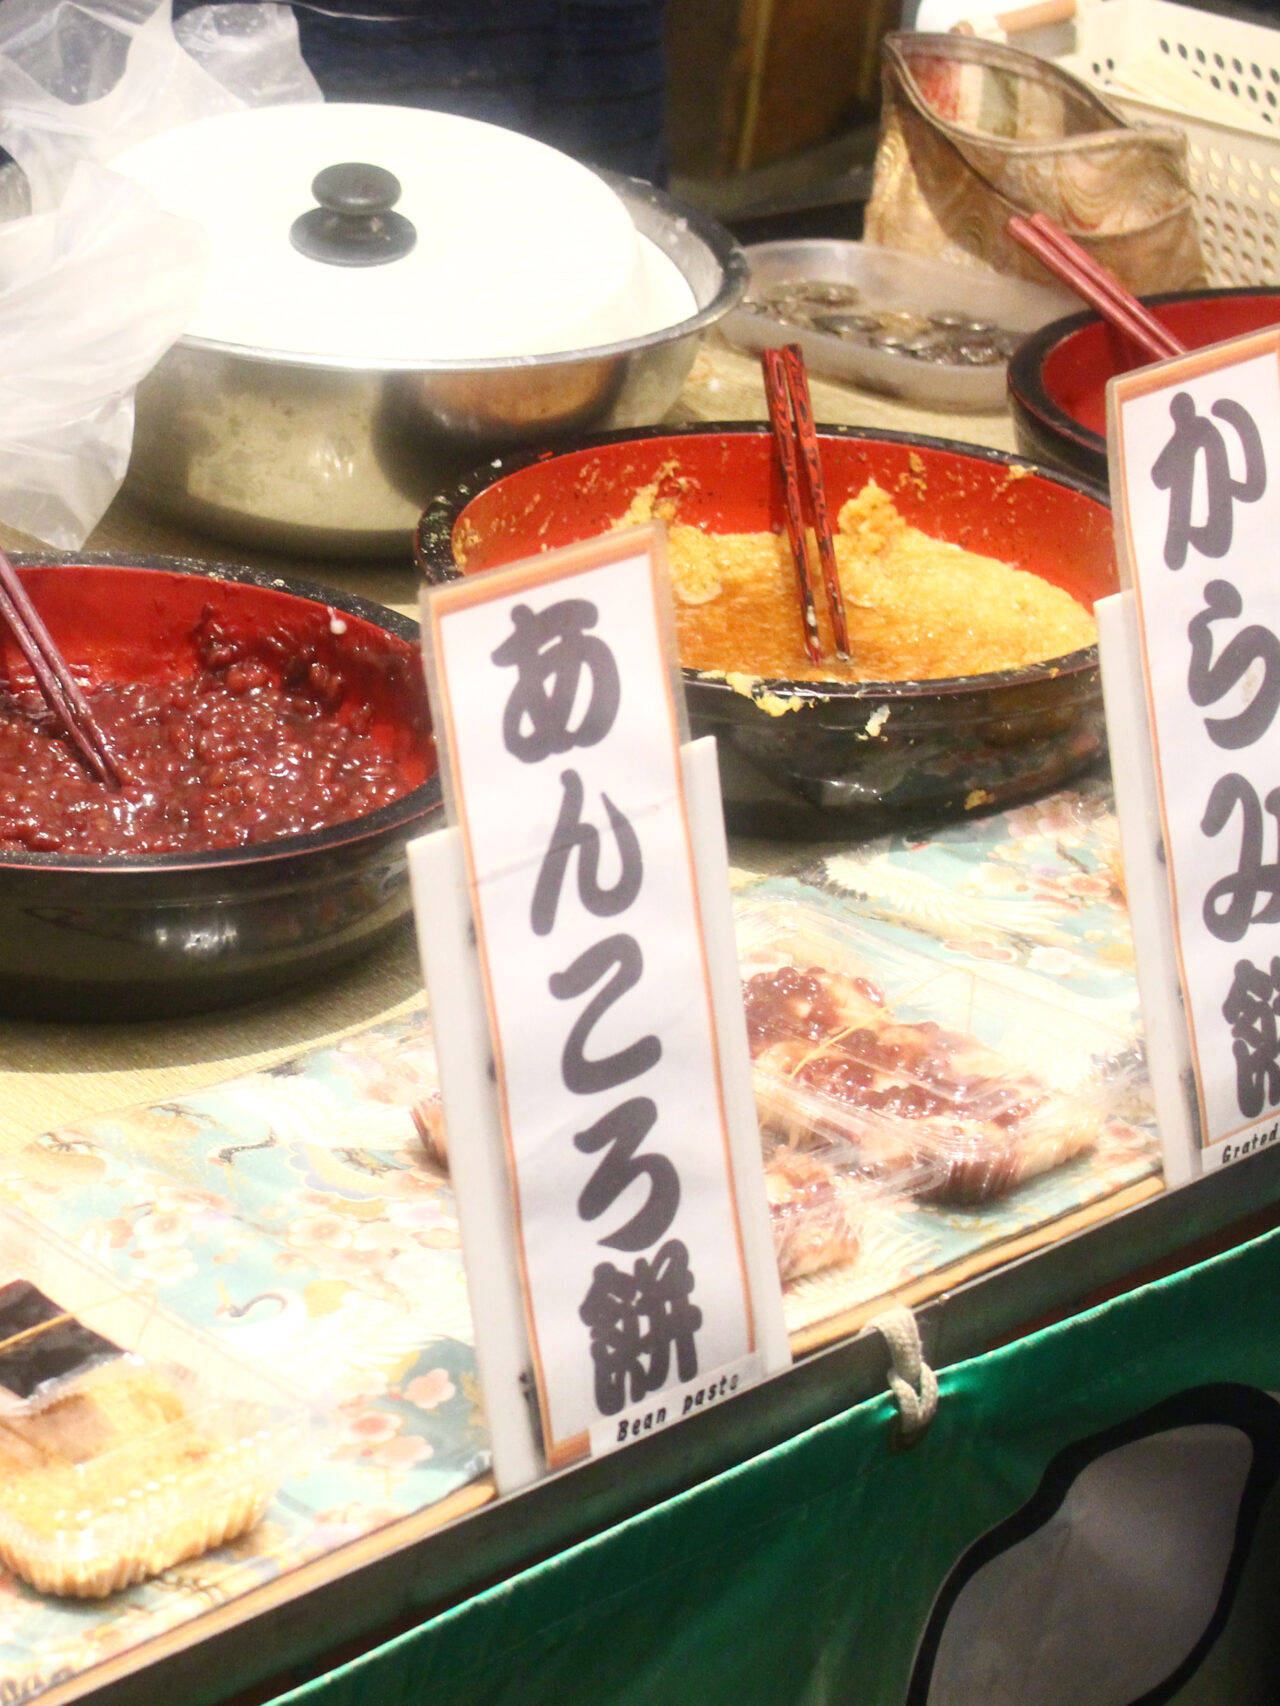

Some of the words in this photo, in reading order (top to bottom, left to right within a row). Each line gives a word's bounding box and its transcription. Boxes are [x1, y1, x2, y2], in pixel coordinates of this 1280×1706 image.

[490, 598, 703, 1416] あんころ餅
[1221, 1121, 1279, 1165] Grated
[617, 1406, 667, 1442] Bean
